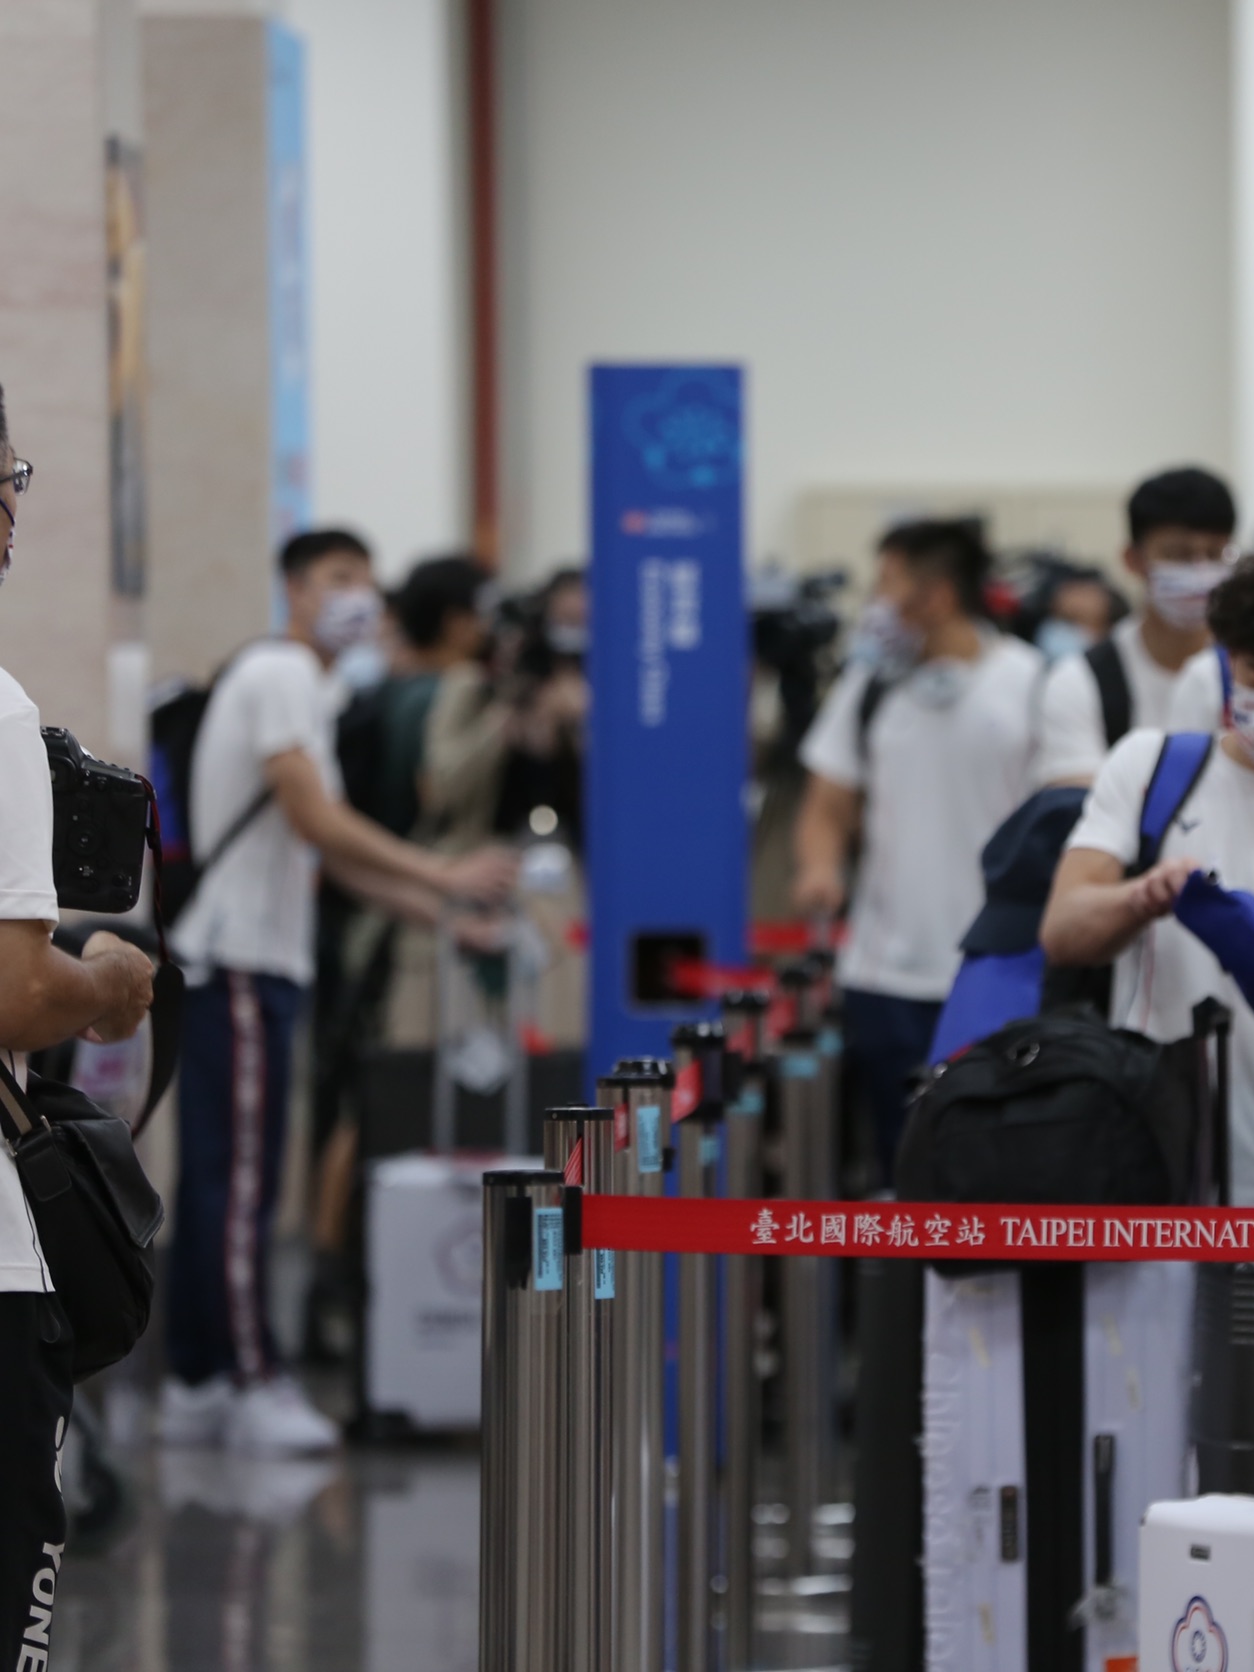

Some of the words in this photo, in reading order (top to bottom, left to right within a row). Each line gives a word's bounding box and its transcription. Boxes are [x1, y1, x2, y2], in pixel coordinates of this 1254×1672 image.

[750, 1207, 986, 1248] 臺北國際航空站
[999, 1216, 1096, 1247] TAIPEI
